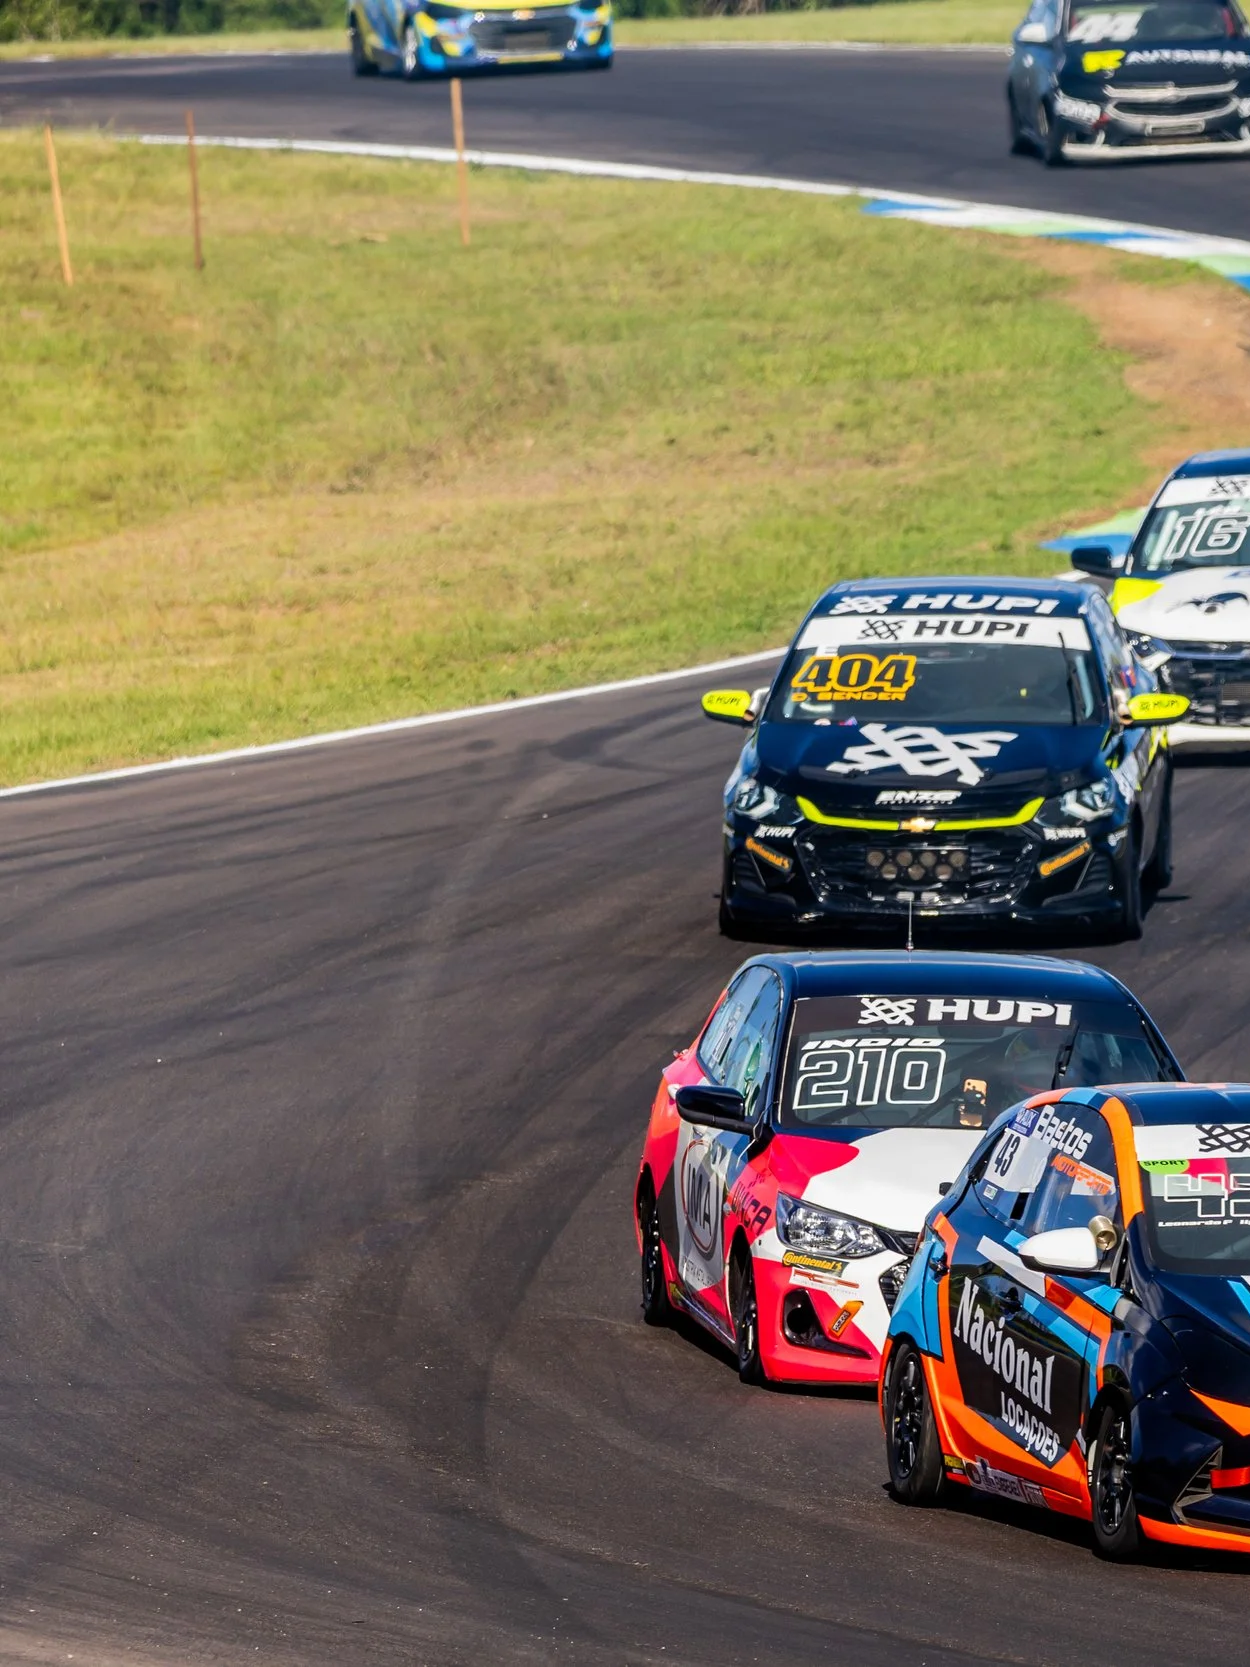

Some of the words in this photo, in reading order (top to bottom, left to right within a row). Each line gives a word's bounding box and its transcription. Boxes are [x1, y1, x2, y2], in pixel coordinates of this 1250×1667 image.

[902, 594, 1061, 615] HUPI
[913, 620, 1030, 638] HUPI
[790, 653, 917, 693] 404
[817, 691, 906, 701] BENDER
[927, 999, 1073, 1026] HUPI
[801, 1038, 946, 1051] INDIO
[792, 1047, 947, 1110] 210
[1033, 1104, 1094, 1160] Bastos
[994, 1133, 1021, 1177] 43
[783, 1252, 836, 1270] Continental
[953, 1275, 1055, 1415] Nacional
